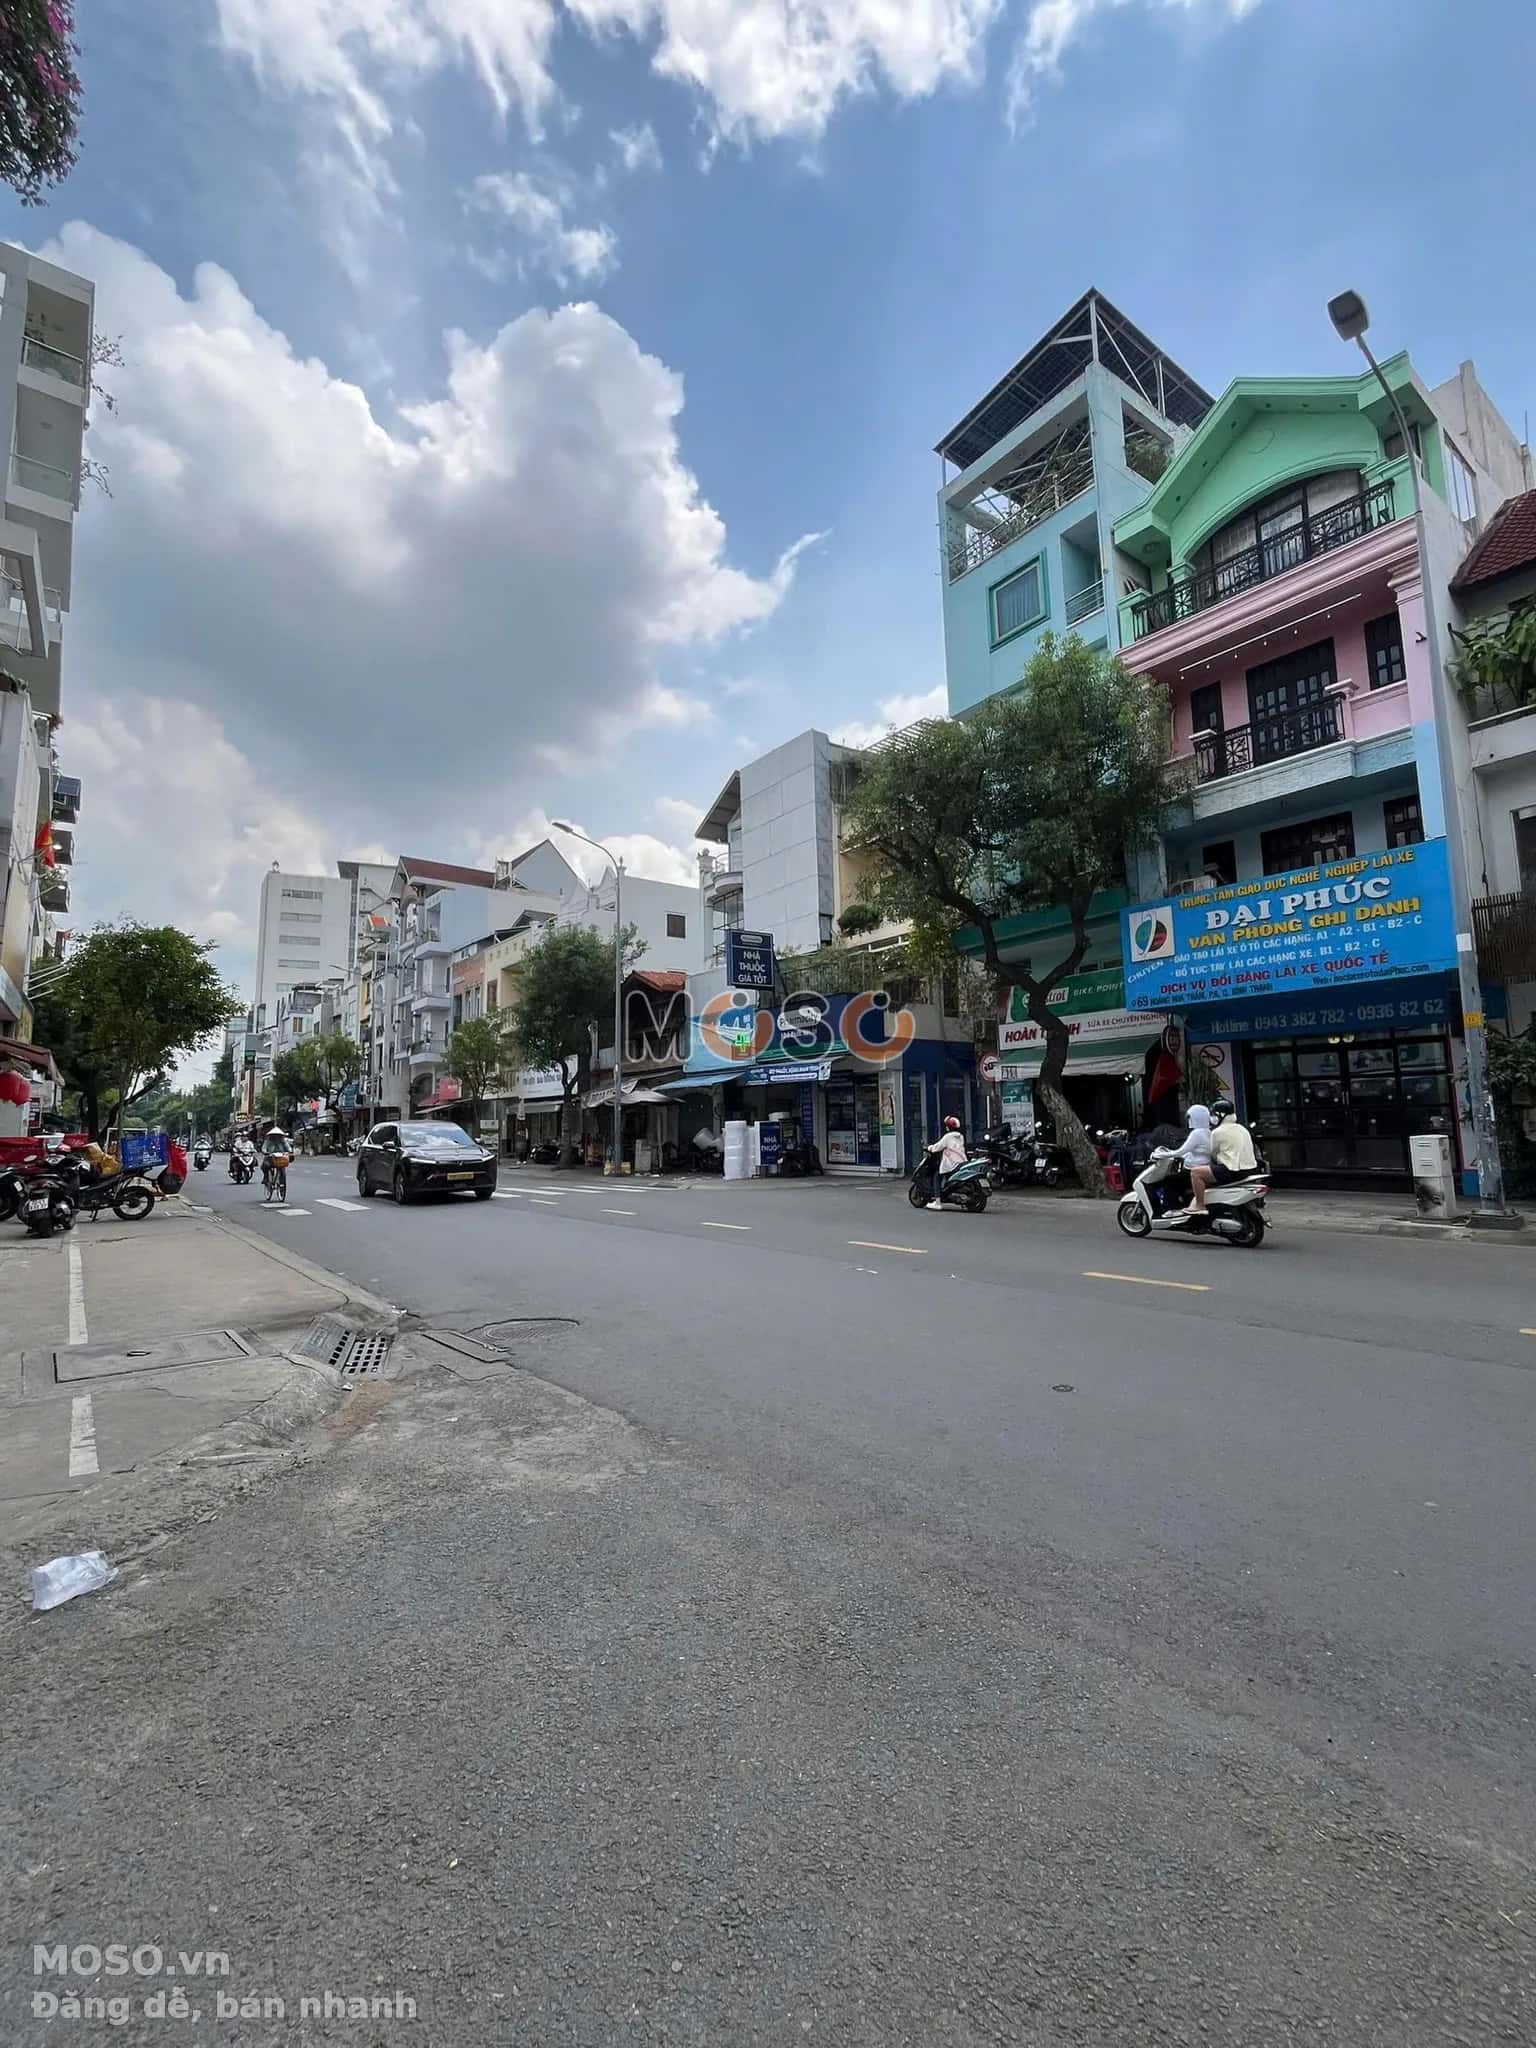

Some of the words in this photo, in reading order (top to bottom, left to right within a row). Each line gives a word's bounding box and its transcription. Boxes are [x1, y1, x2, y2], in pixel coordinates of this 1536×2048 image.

[1399, 849, 1414, 863] XE
[1205, 899, 1272, 930] ĐẠI
[1280, 875, 1392, 916] PHÚC
[1232, 918, 1303, 942] PHÒNG
[1309, 910, 1348, 929] GHI
[1355, 897, 1420, 921] DANH
[1227, 945, 1239, 954] XE
[1316, 931, 1328, 941] A1
[1339, 926, 1353, 937] A2
[1363, 922, 1377, 933] B1
[1387, 918, 1403, 929] B2
[1414, 915, 1423, 925] C
[743, 949, 761, 960] NHÀ
[1320, 946, 1333, 956] B1
[1345, 941, 1360, 952] B2
[1372, 938, 1381, 948] C
[739, 960, 766, 973] THUỐC
[738, 973, 752, 983] GIÁ
[753, 972, 768, 984] TỐT
[1160, 982, 1187, 995] DỊCH
[1190, 980, 1207, 992] VỤ
[1301, 962, 1319, 975] XE
[1292, 1011, 1318, 1027] 382
[1320, 1009, 1345, 1025] 782
[1357, 1002, 1394, 1021] 0936
[1400, 1000, 1420, 1016] 82
[1424, 998, 1444, 1015] 62
[1004, 1024, 1037, 1043] HOÀN
[1040, 1022, 1081, 1039] TNH
